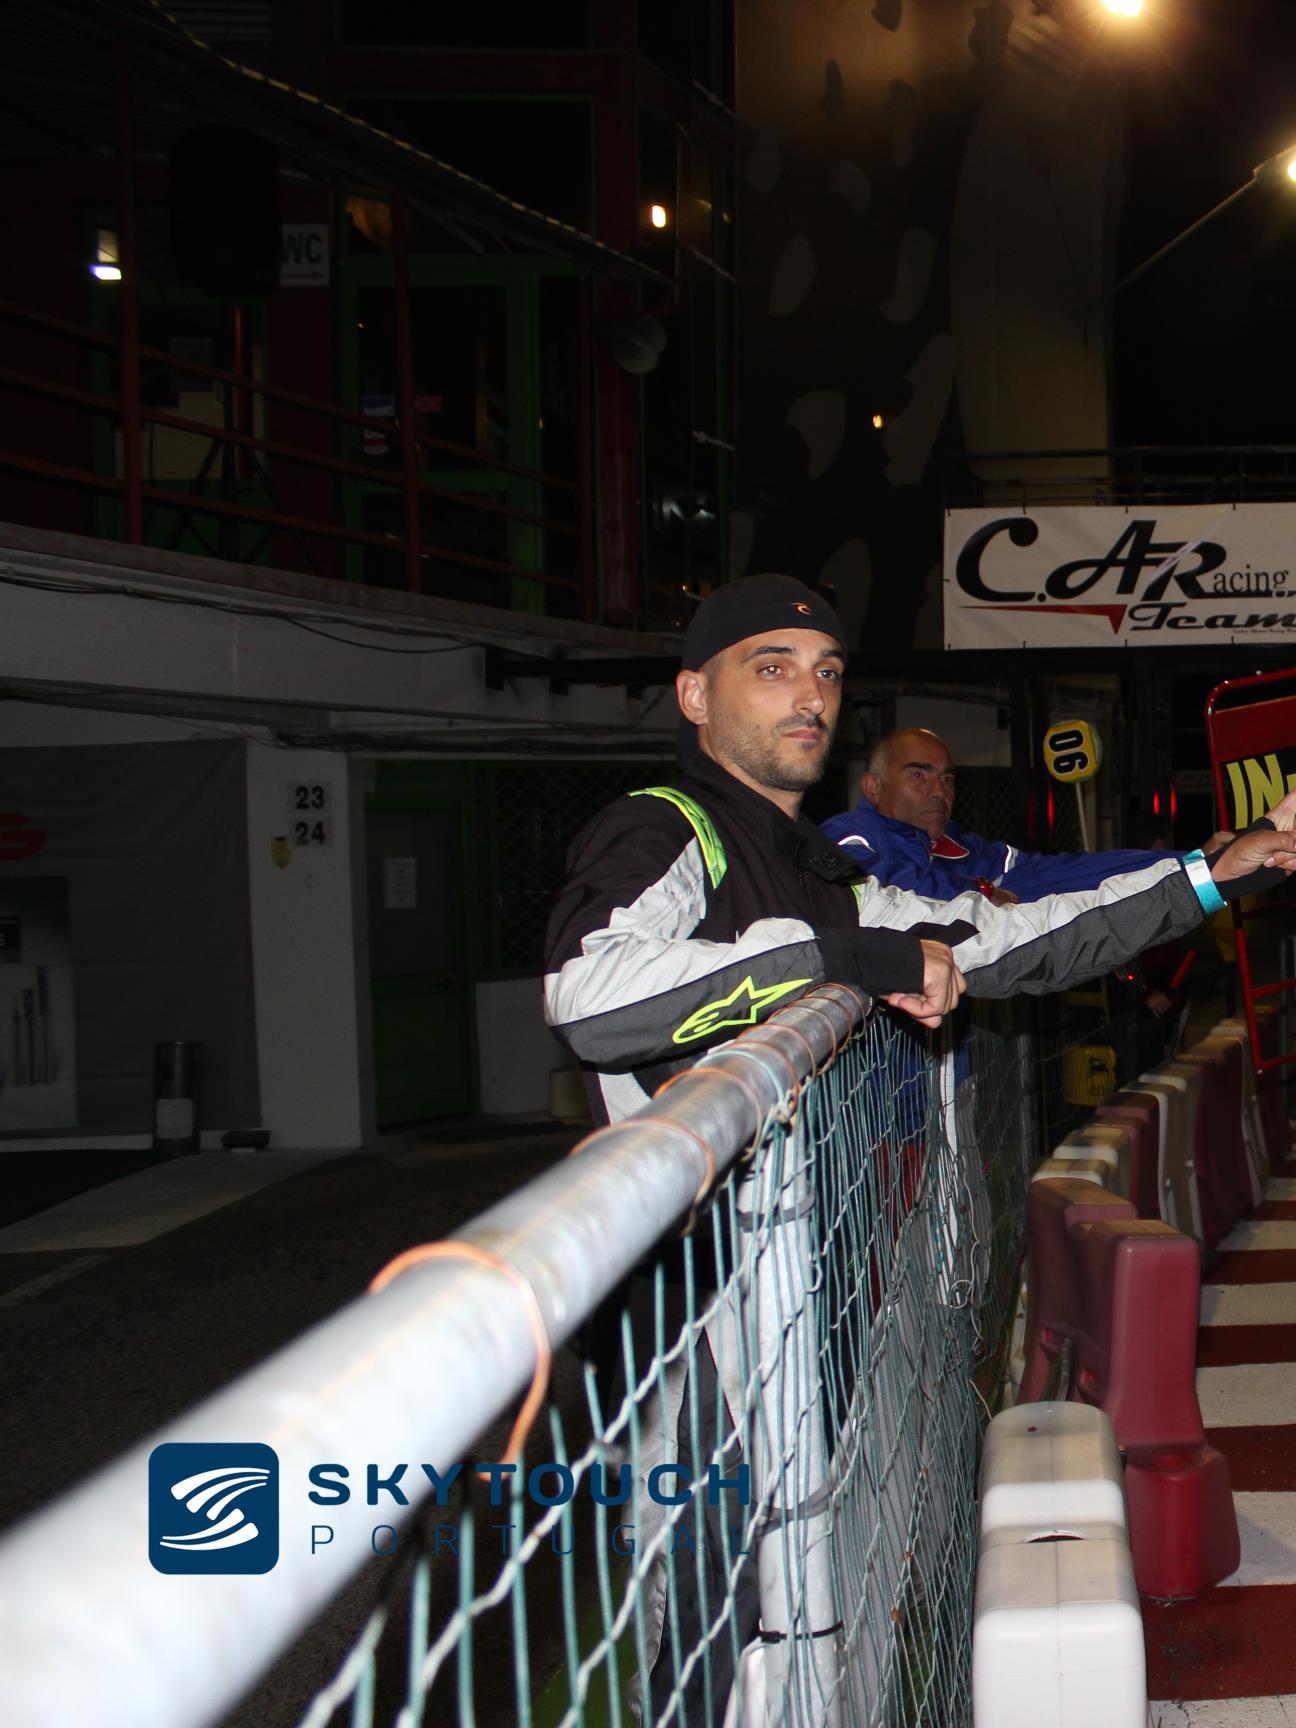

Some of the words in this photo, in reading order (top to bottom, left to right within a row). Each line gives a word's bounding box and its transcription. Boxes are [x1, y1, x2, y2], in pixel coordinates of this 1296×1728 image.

[284, 234, 323, 263] WC
[296, 786, 325, 809] 23
[295, 821, 326, 845] 24
